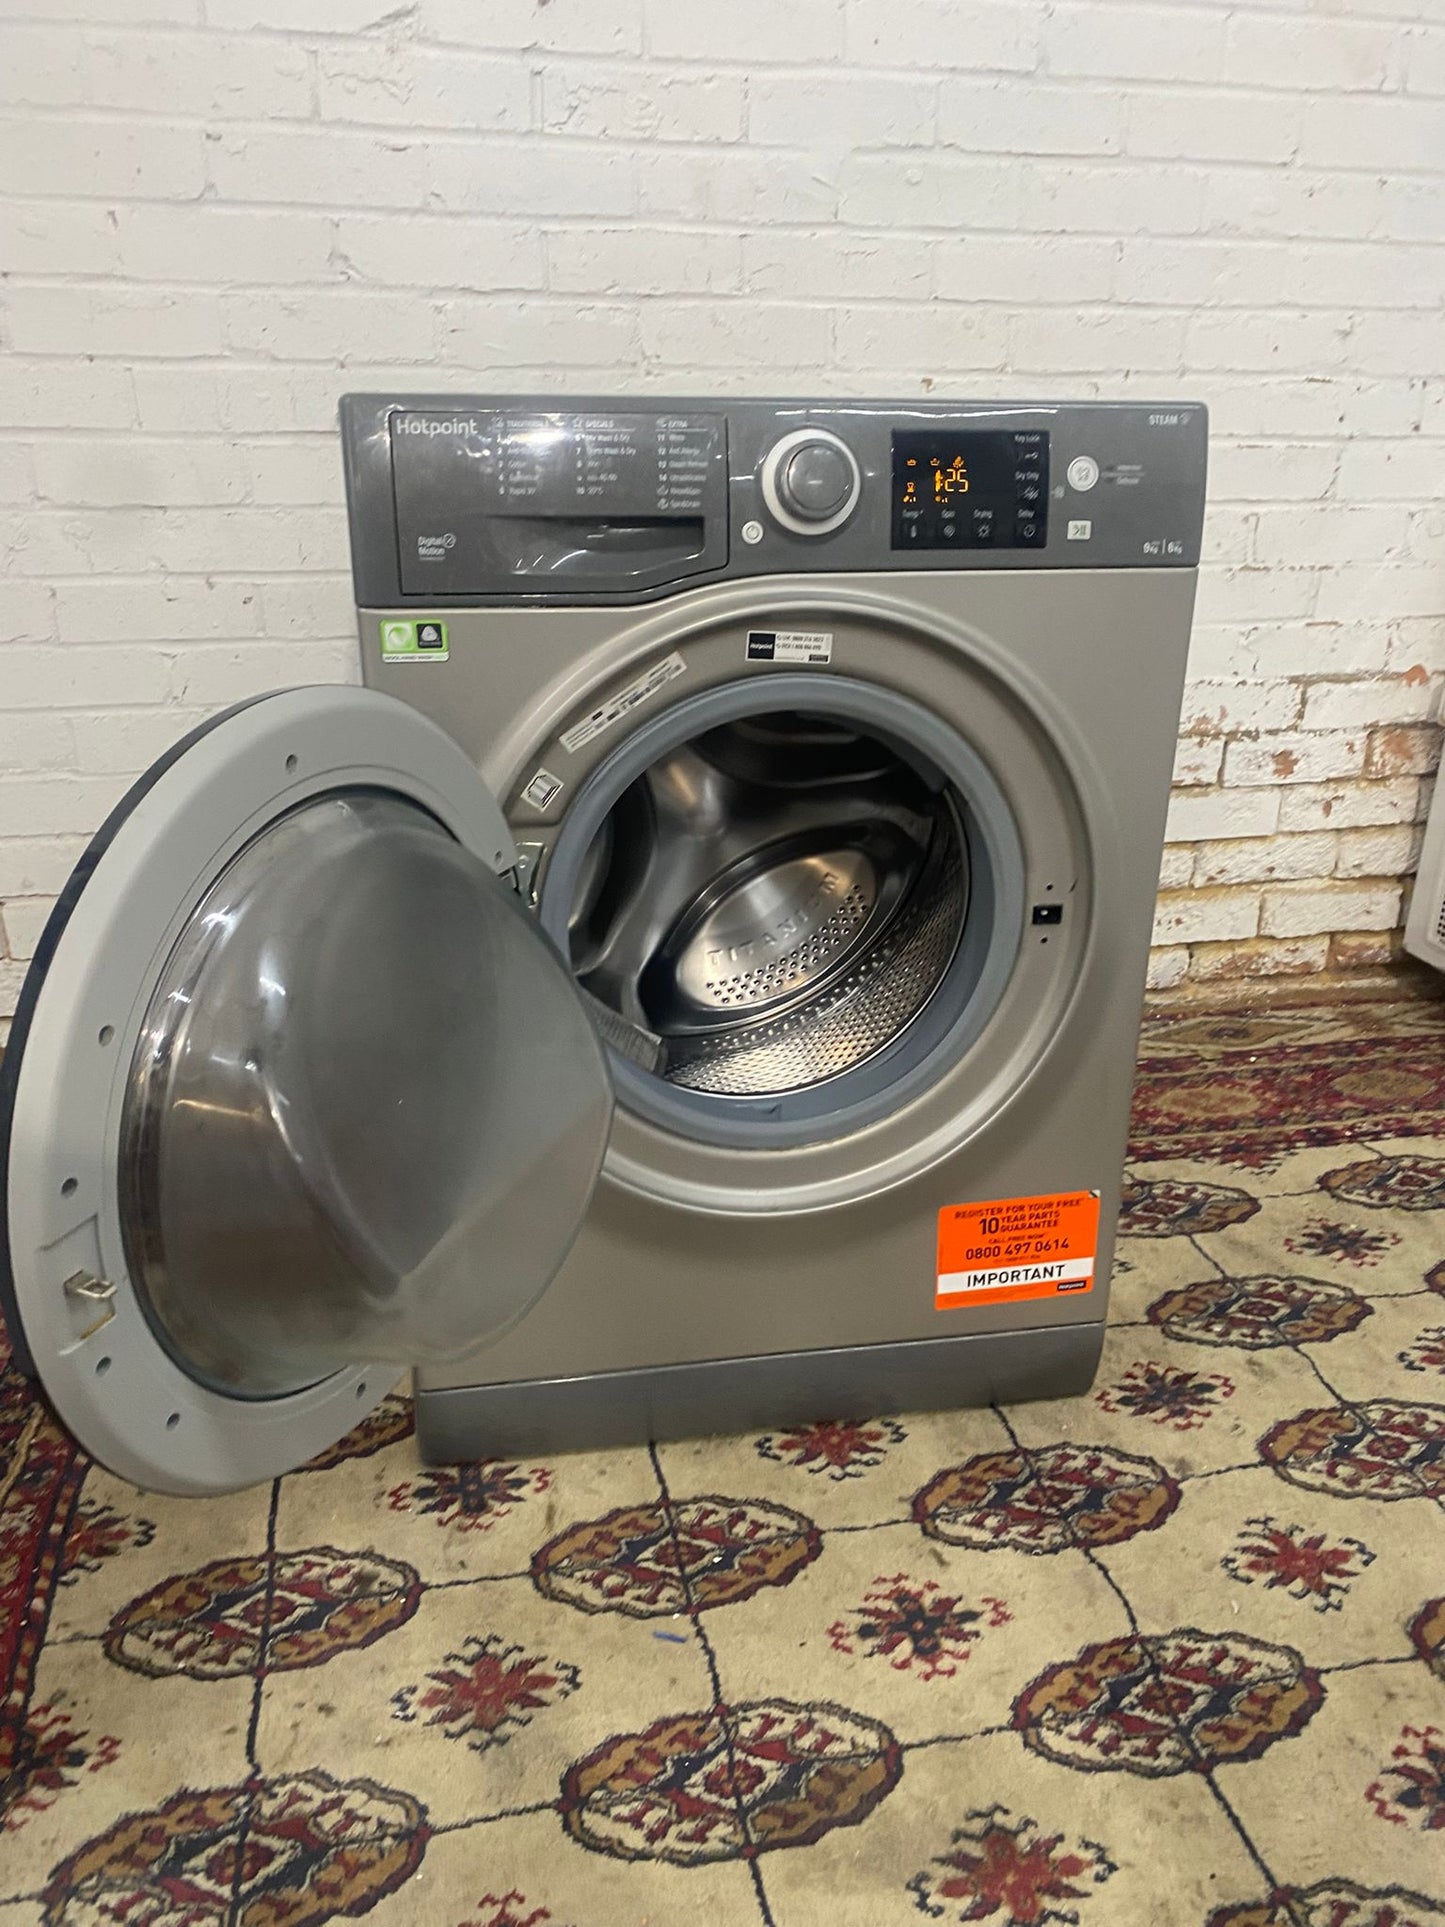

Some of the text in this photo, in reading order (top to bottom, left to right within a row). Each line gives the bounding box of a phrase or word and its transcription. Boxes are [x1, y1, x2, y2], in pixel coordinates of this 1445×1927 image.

[396, 418, 478, 438] Hotpoint
[1148, 414, 1178, 425] STEAM
[417, 536, 443, 547] Digital
[954, 1206, 1003, 1219] REGISTER
[1006, 1204, 1025, 1215] FOR
[1027, 1201, 1054, 1212] YOUR
[979, 1210, 1060, 1235] 10 YEAR PARTS
[1000, 1219, 1059, 1233] GUARANTEE
[965, 1245, 1002, 1260] 0800
[1004, 1241, 1031, 1256] 497
[1034, 1237, 1070, 1253] 0614
[966, 1264, 1066, 1288] IMPORTANT
